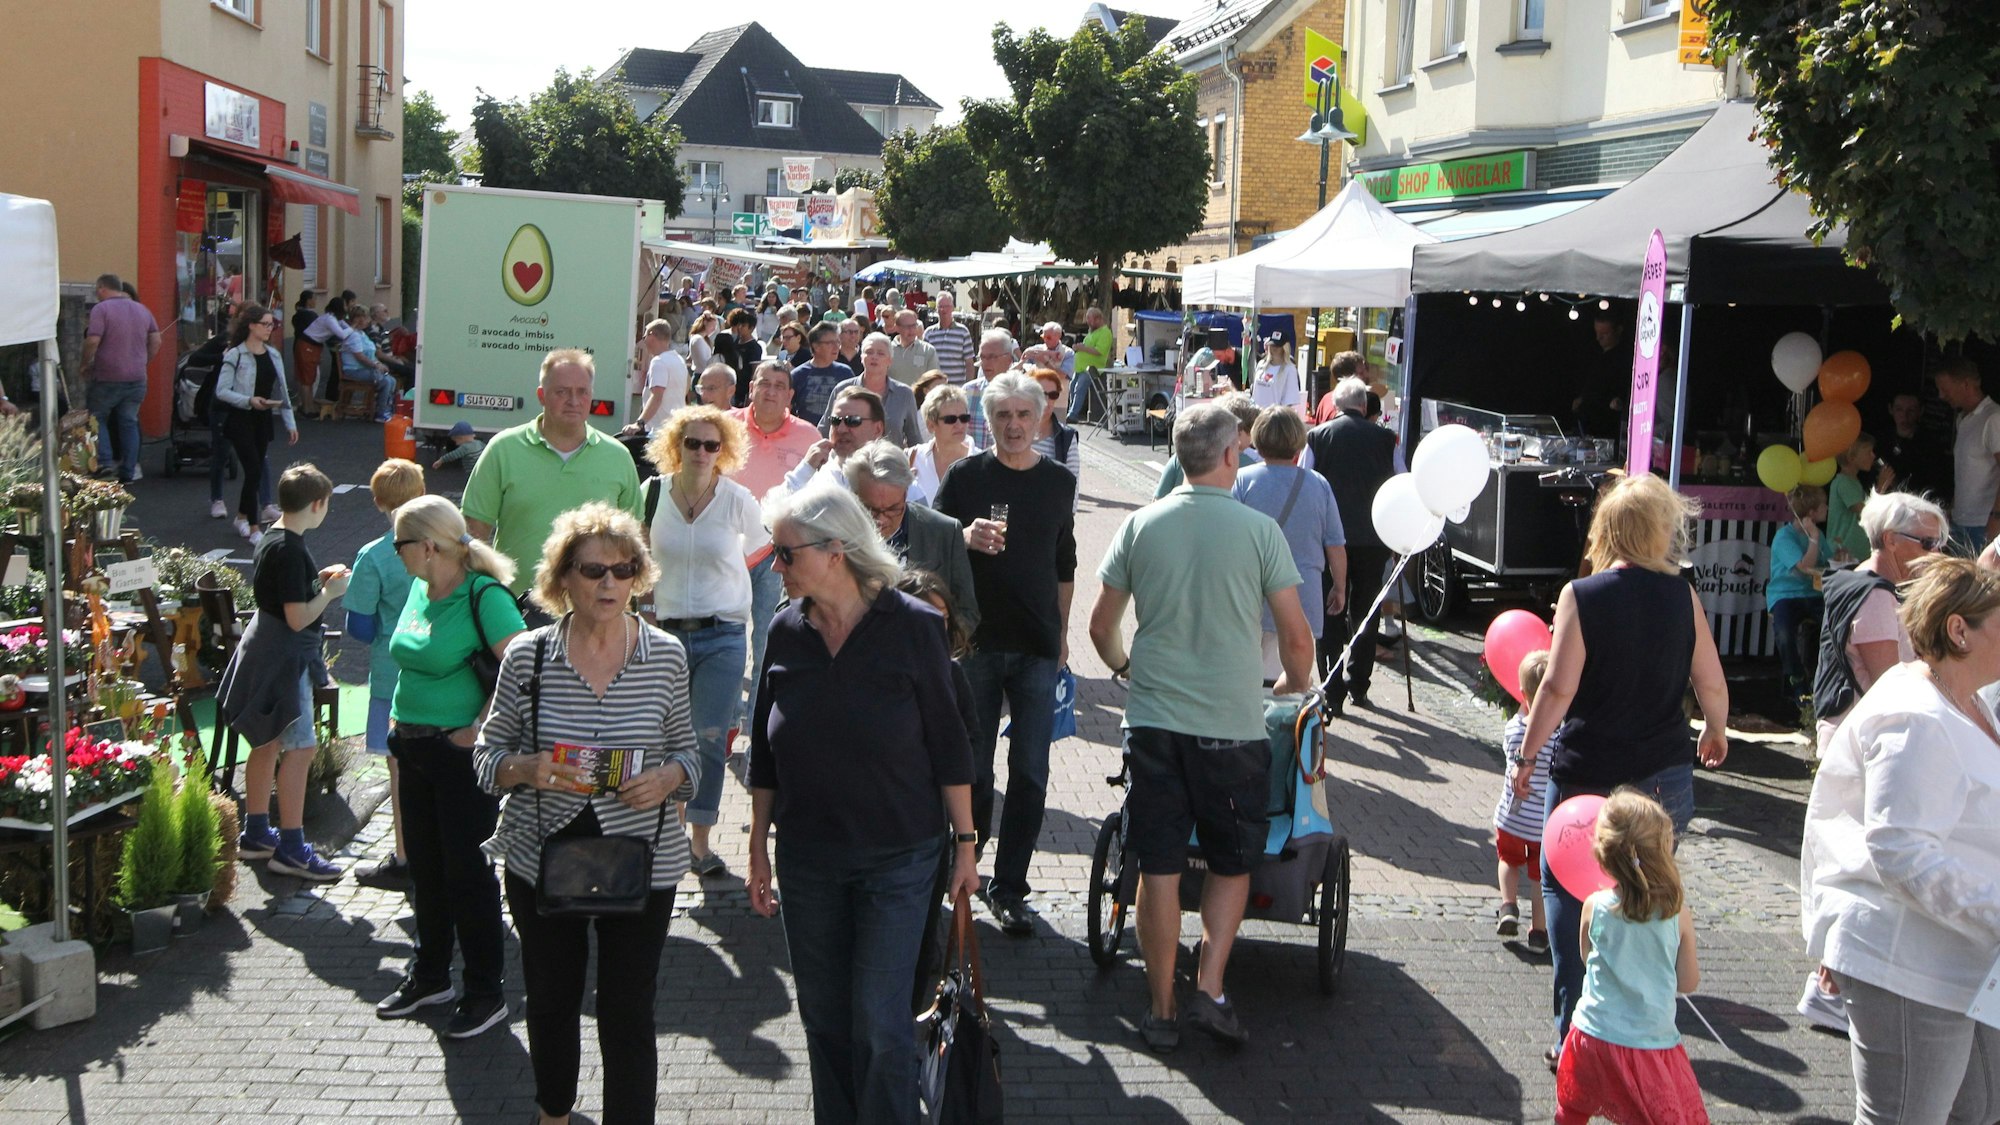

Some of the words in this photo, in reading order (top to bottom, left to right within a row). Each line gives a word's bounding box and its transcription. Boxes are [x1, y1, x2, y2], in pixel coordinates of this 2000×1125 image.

[1365, 175, 1392, 197] OTTO
[1399, 171, 1430, 195] SHOP
[1437, 160, 1512, 191] HANGELAR
[482, 329, 555, 340] avocado_imbiss
[135, 565, 145, 573] im
[1695, 562, 1729, 580] Velo
[116, 577, 142, 588] Garten
